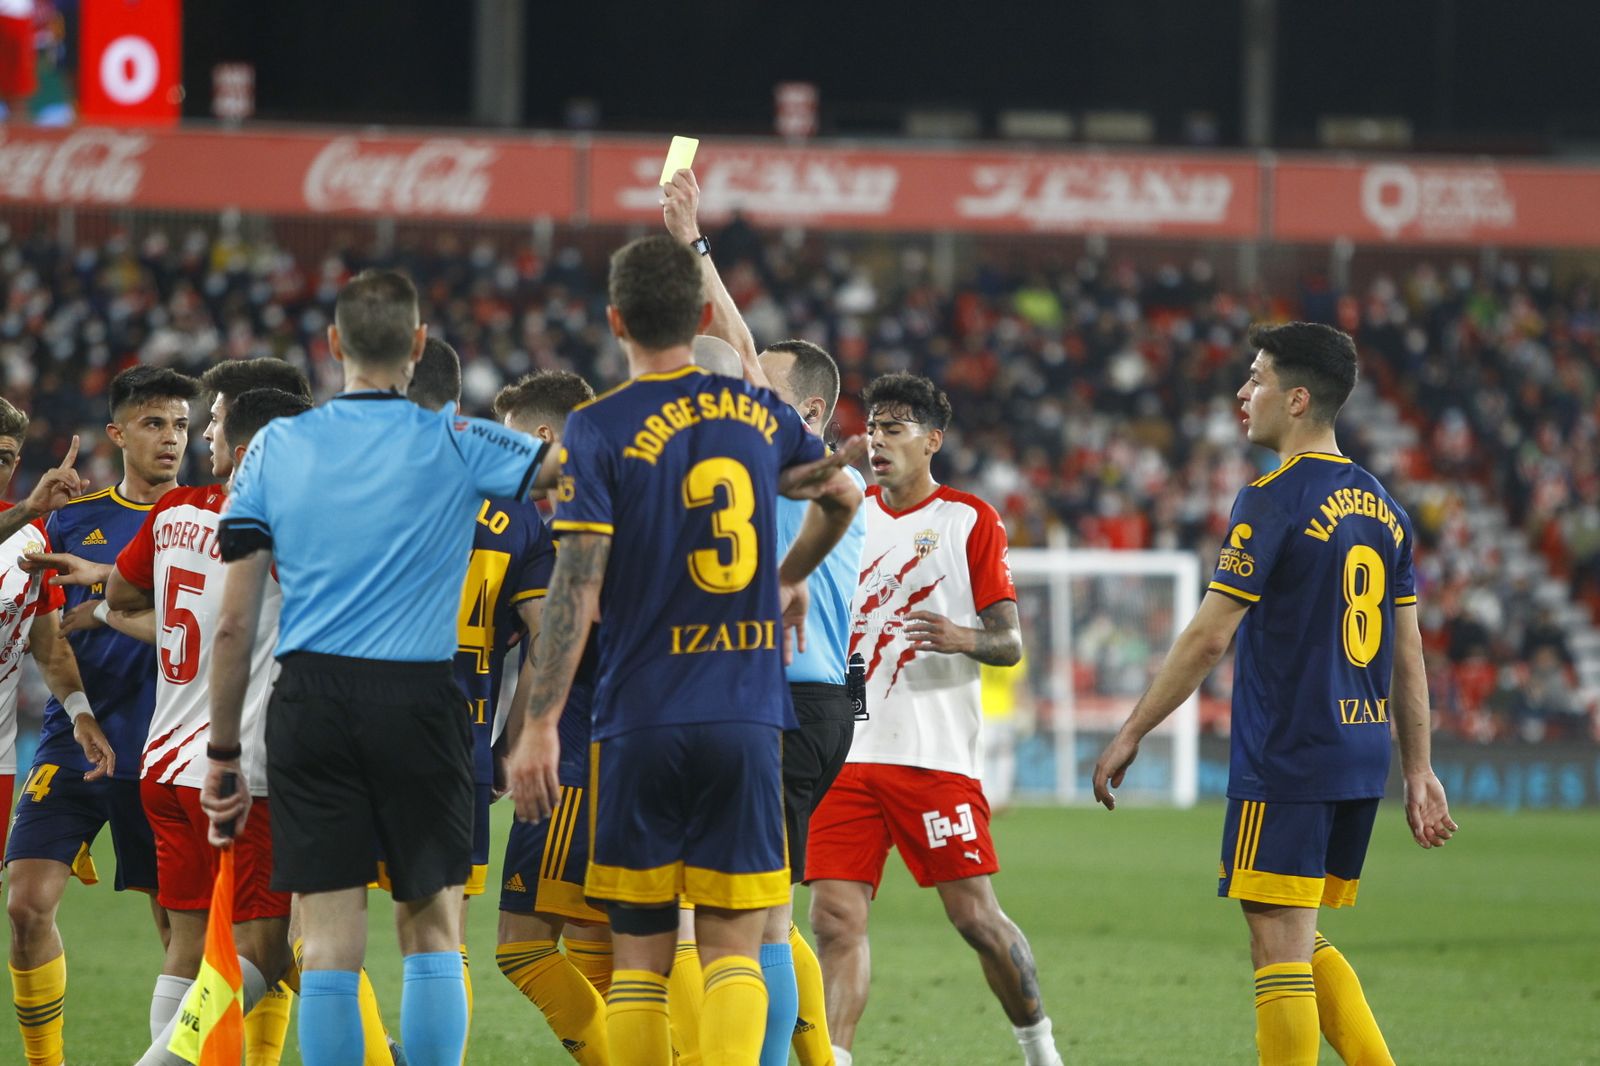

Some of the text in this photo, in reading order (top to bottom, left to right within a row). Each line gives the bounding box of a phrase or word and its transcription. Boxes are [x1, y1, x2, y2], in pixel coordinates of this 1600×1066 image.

[99, 35, 159, 105] 0
[623, 388, 779, 466] JORGE SÁENZ
[682, 457, 759, 595] 3
[1304, 488, 1405, 548] V.MESEGUER
[161, 565, 207, 685] 5
[669, 621, 776, 654] IZADI
[1343, 545, 1386, 668] 8
